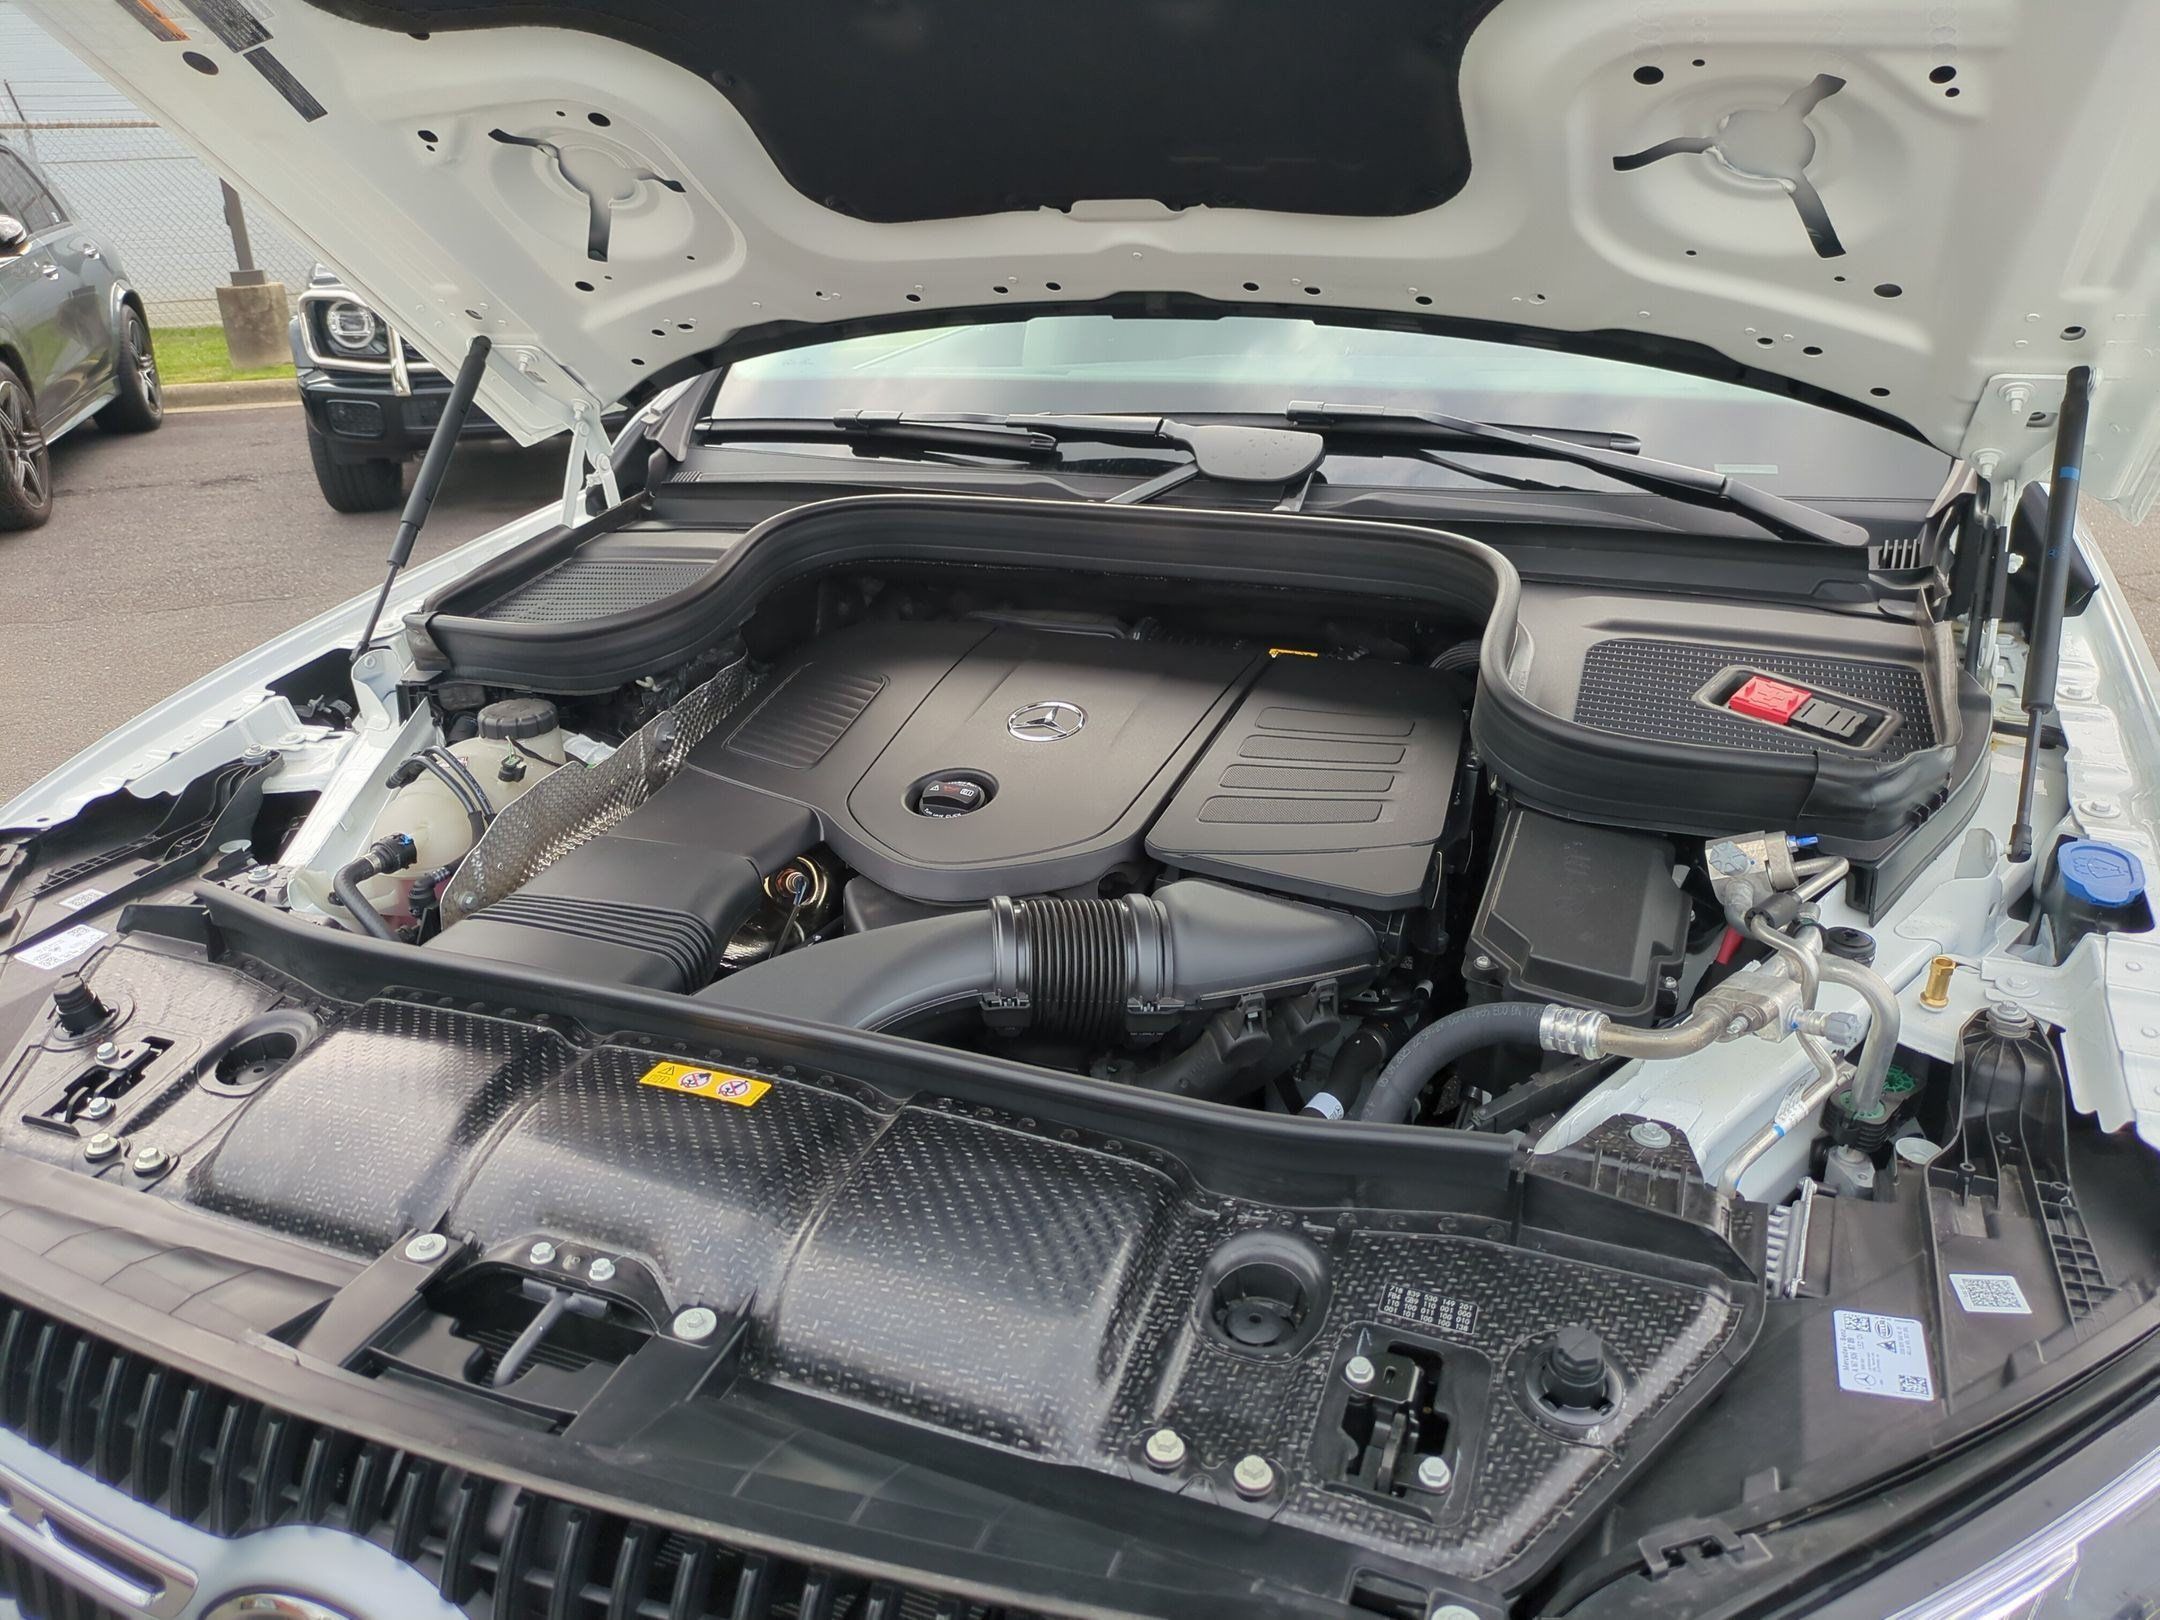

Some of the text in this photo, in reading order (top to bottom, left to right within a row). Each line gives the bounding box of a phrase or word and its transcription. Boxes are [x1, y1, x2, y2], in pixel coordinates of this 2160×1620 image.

[1440, 1306, 1454, 1314] 001
[1442, 1299, 1456, 1307] 149
[1383, 1306, 1398, 1314] 001
[1402, 1310, 1415, 1318] 101
[1420, 1315, 1434, 1323] 100
[1437, 1320, 1451, 1328] 100
[1386, 1299, 1470, 1325] 110 100 011 100 010
